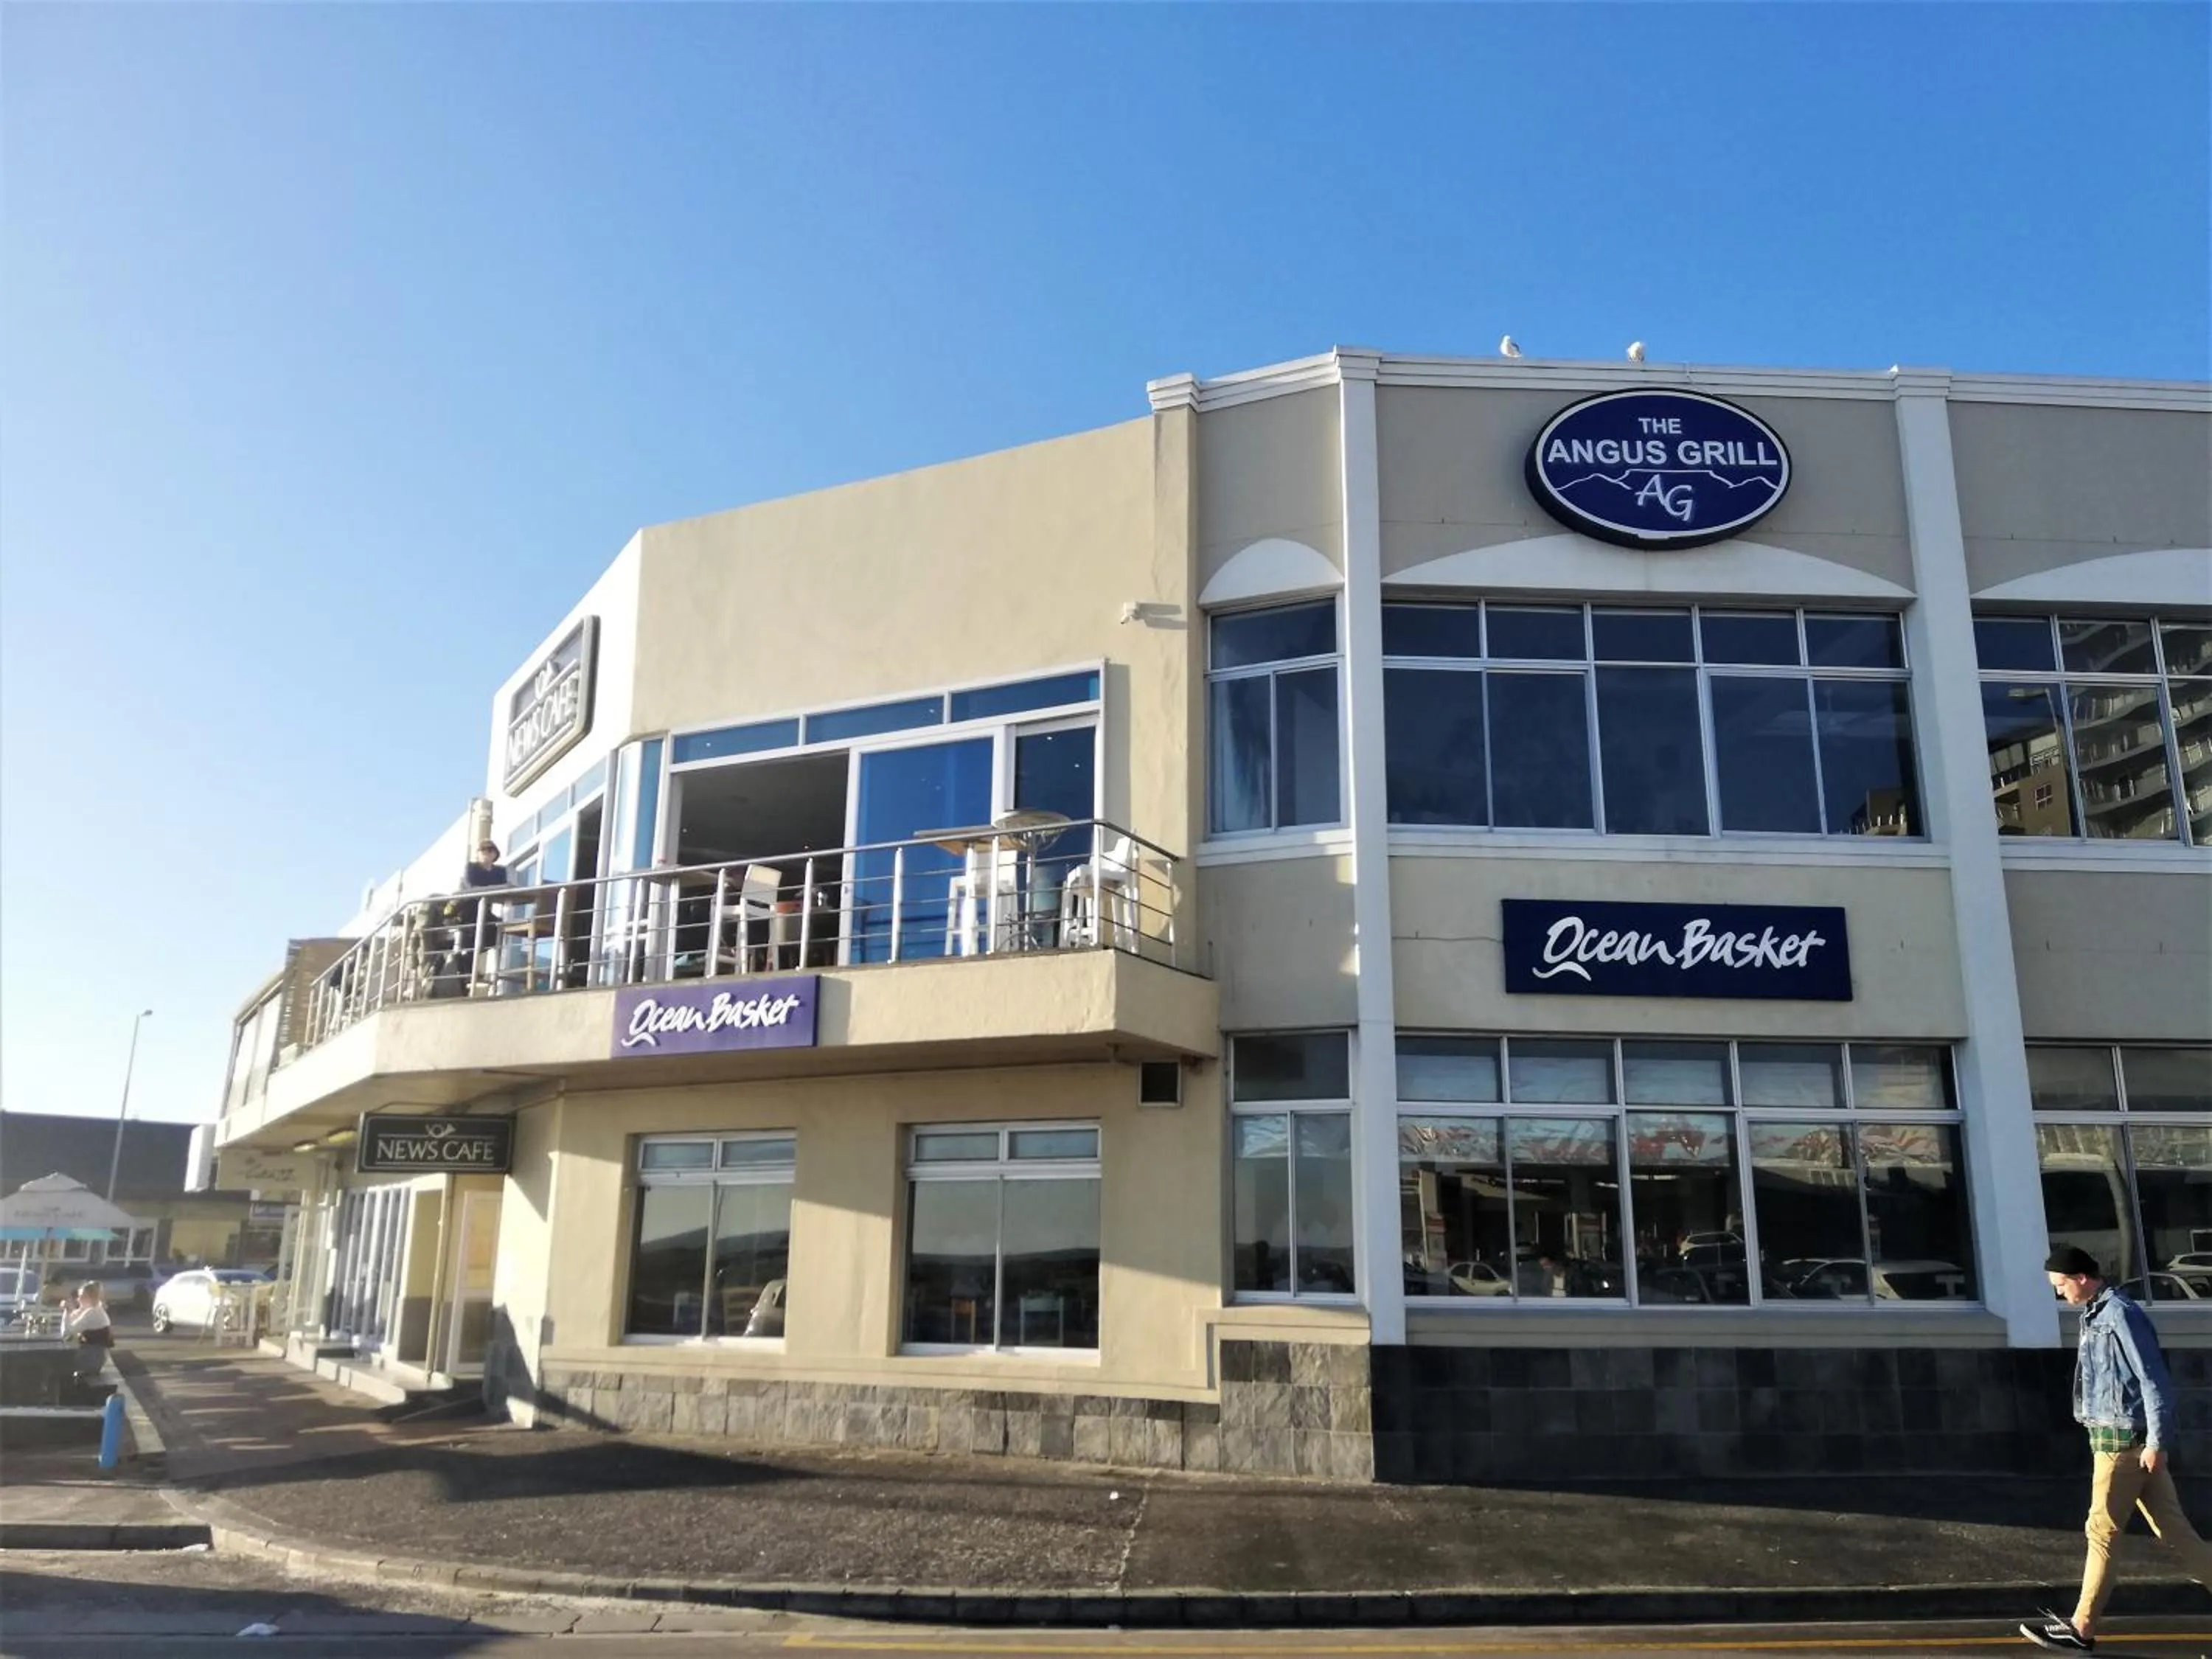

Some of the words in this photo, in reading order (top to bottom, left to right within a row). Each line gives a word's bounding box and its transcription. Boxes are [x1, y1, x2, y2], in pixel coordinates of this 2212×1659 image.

[1638, 417, 1683, 434] THE
[1548, 439, 1667, 465] ANGUS
[1677, 441, 1778, 465] GRILL
[1635, 473, 1694, 521] AG
[1533, 916, 1676, 981] Ocean
[1675, 918, 1826, 969] Basket
[621, 998, 706, 1046] Ocean
[706, 992, 800, 1032] Basket
[377, 1139, 439, 1160] NEWS
[442, 1141, 495, 1161] CAFE
